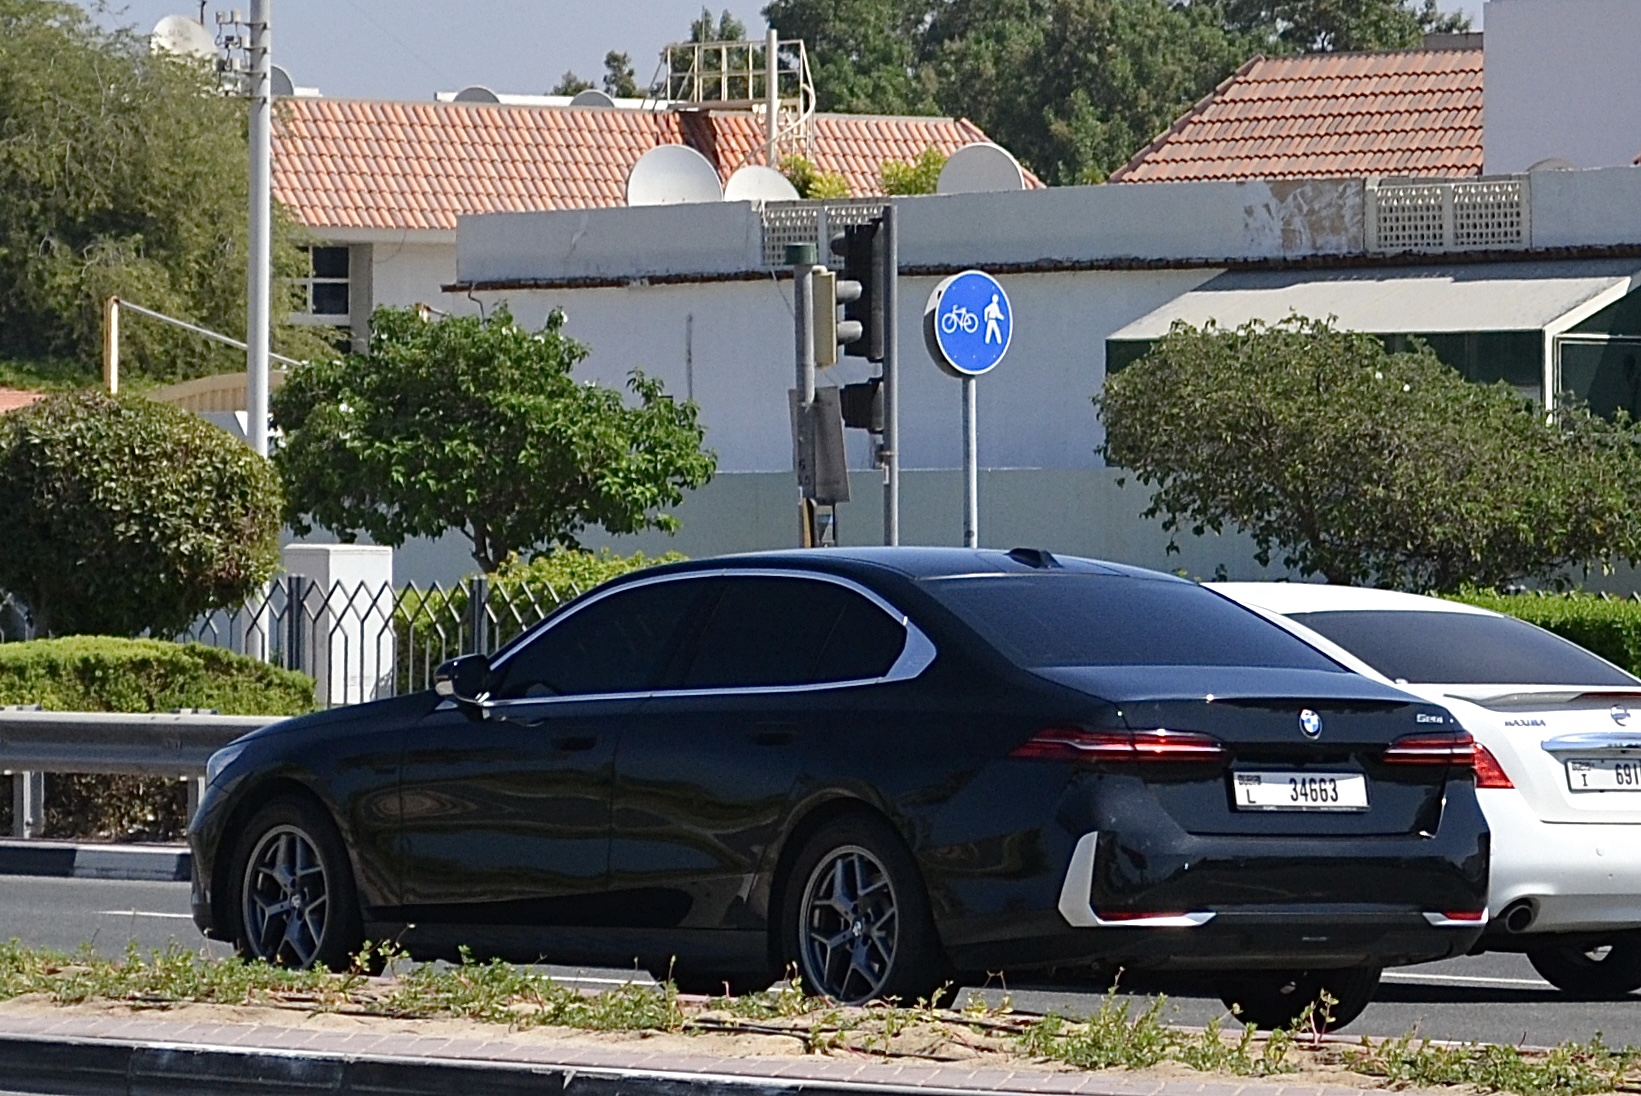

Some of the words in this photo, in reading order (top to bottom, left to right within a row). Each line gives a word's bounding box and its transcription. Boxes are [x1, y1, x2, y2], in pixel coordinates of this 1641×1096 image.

[1615, 763, 1641, 786] 691
[1246, 788, 1257, 804] L
[1288, 777, 1339, 802] 34663
